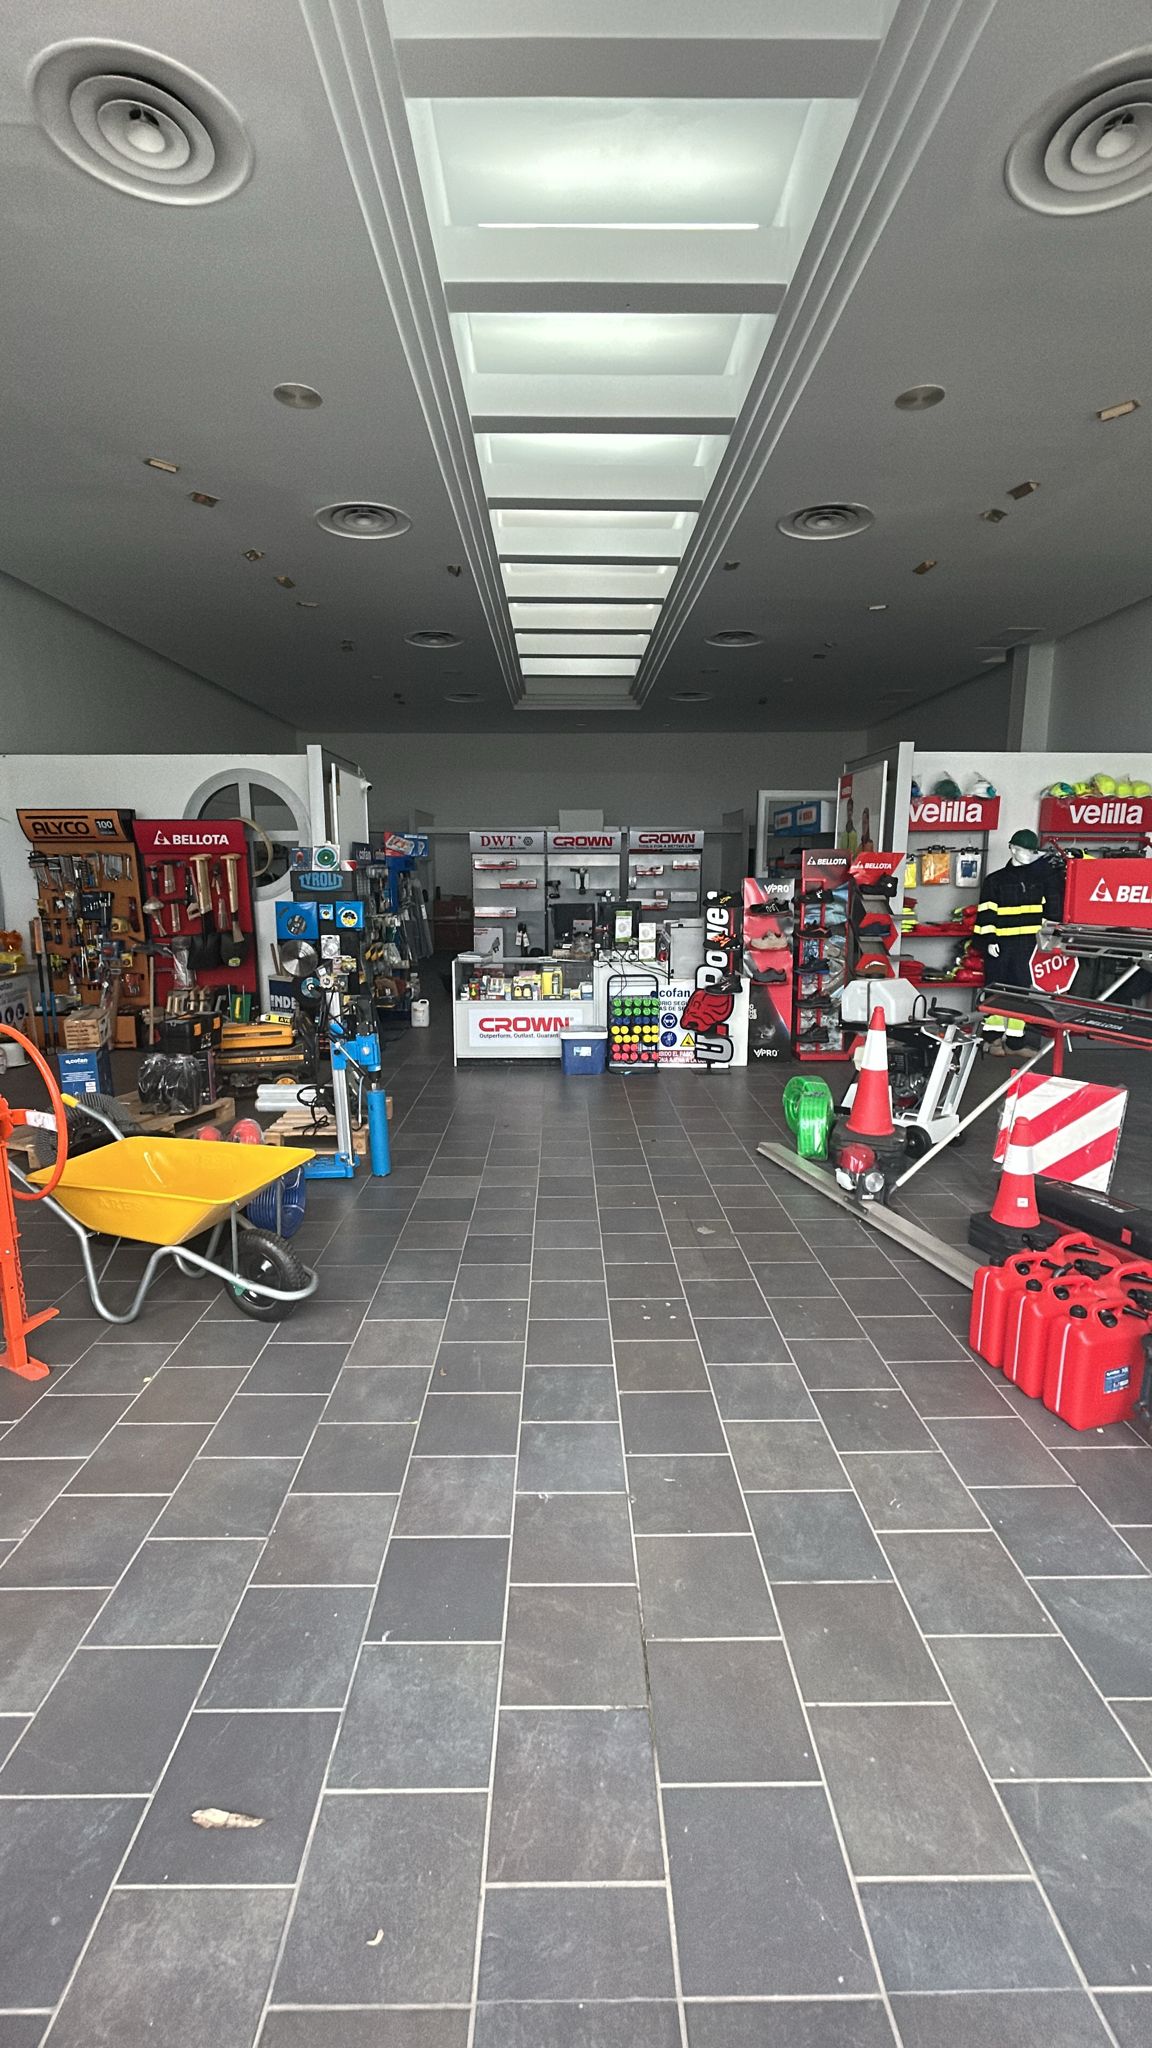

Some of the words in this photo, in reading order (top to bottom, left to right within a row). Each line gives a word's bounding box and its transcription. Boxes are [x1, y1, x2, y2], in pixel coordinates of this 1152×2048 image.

[909, 800, 982, 823] velilla
[1069, 802, 1144, 825] velilla
[32, 821, 90, 835] ALYCO
[96, 820, 113, 829] 100
[172, 834, 230, 845] BELLOTA
[480, 835, 517, 847] DWT
[553, 836, 613, 847] CROWN
[638, 833, 696, 844] CROWN
[817, 858, 847, 866] BELLOTA
[864, 862, 892, 870] BELLOTA
[299, 872, 344, 888] TYROLIT
[660, 987, 691, 998] cofan
[478, 1016, 570, 1032] CROWN
